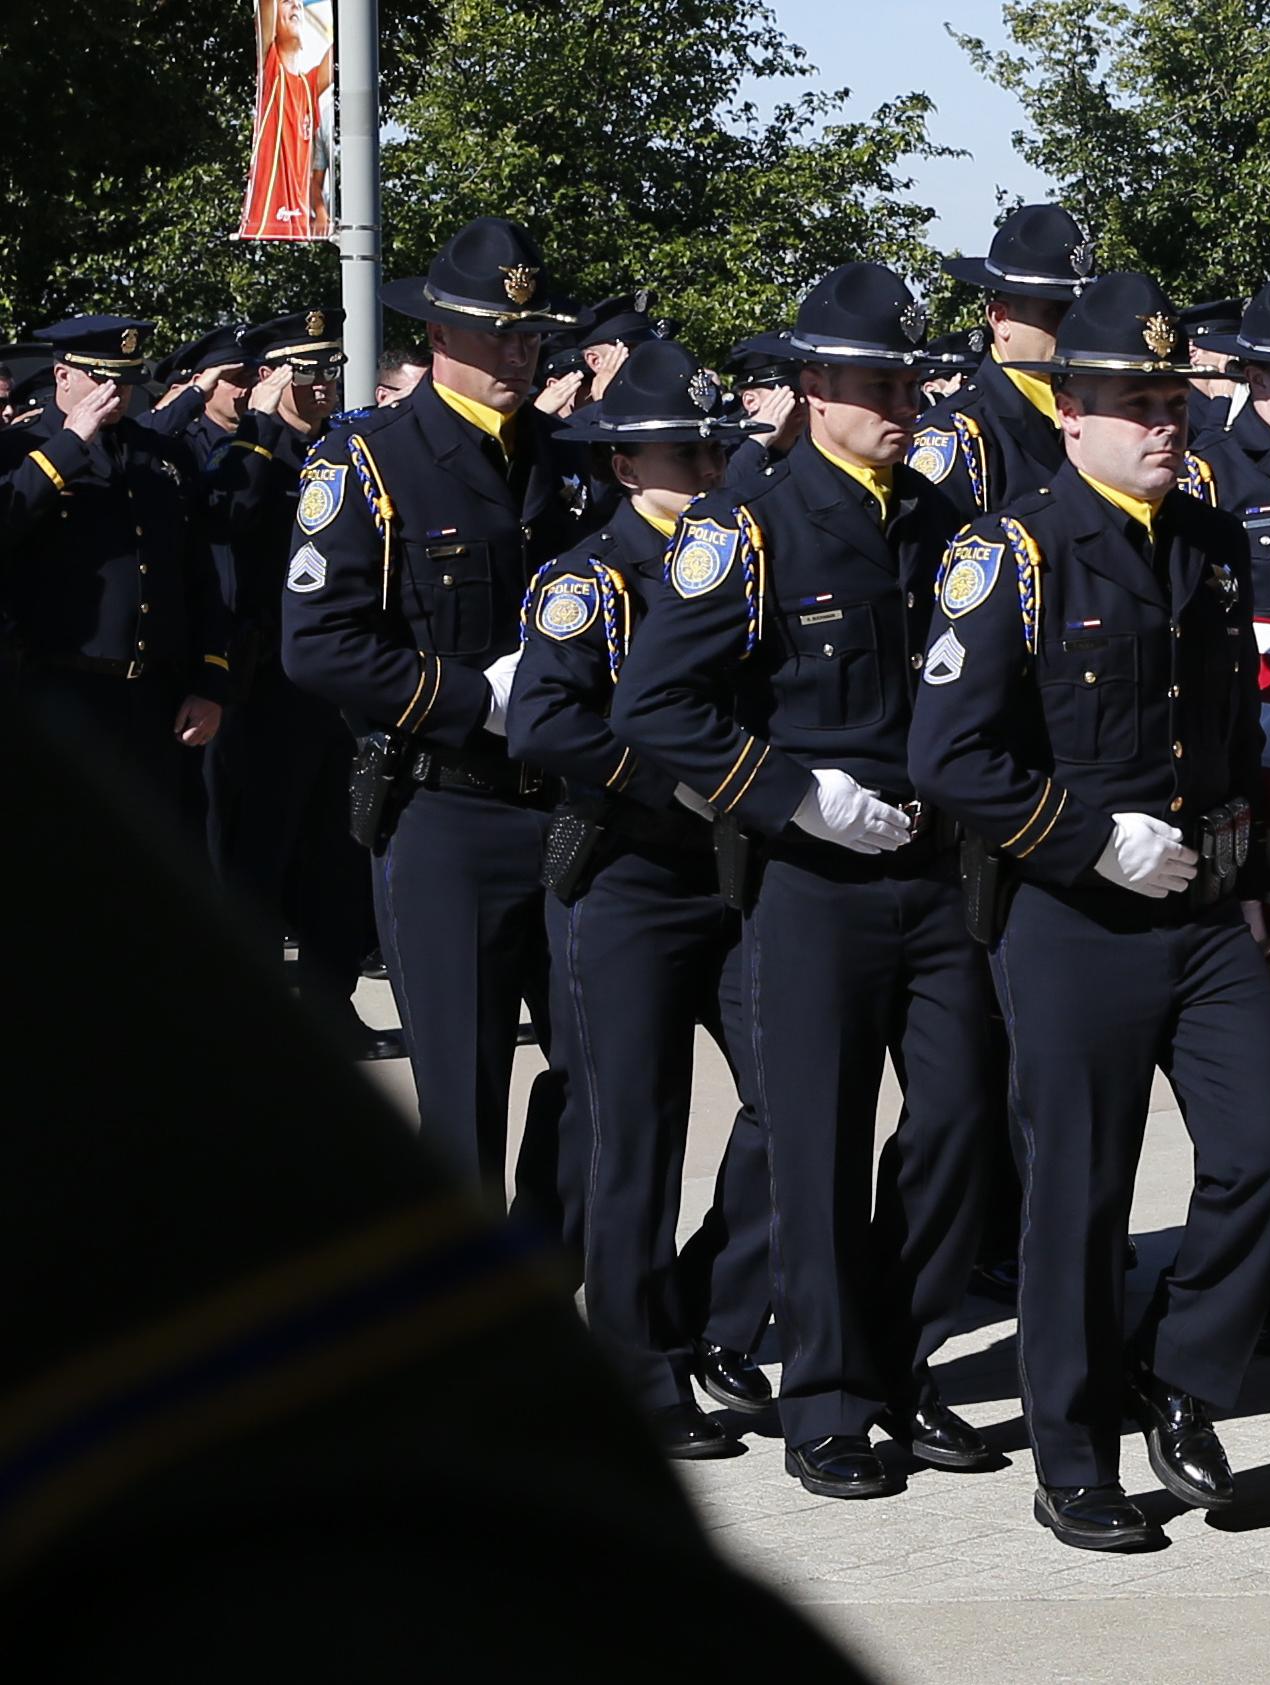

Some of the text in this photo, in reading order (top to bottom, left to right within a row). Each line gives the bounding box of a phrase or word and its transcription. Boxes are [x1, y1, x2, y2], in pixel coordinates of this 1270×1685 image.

[914, 436, 949, 448] POLICE
[687, 525, 728, 546] POLICE
[955, 547, 992, 561] POLICE
[547, 583, 590, 596] POLICE
